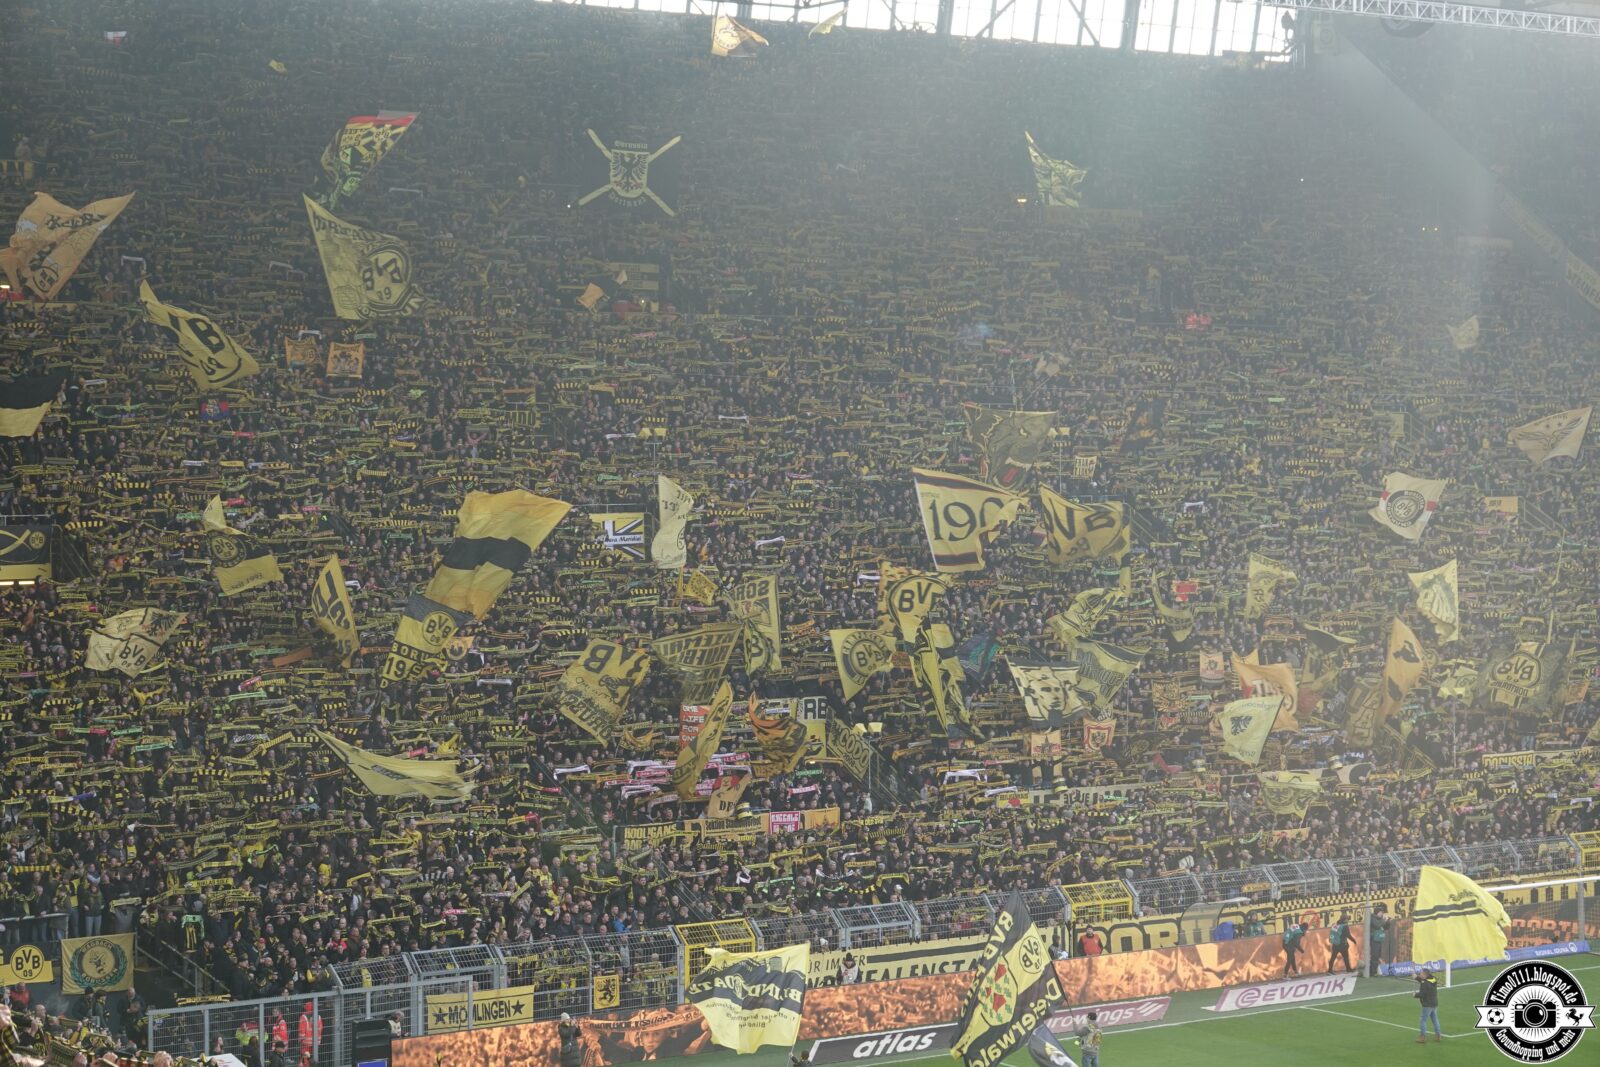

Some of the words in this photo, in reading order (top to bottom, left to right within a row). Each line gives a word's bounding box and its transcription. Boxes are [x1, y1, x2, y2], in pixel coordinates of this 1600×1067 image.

[425, 615, 452, 638] BVB
[624, 824, 678, 840] HOOLIGANS
[15, 949, 41, 970] BVB
[1262, 978, 1348, 1002] EVONIK
[853, 1031, 937, 1059] atlas
